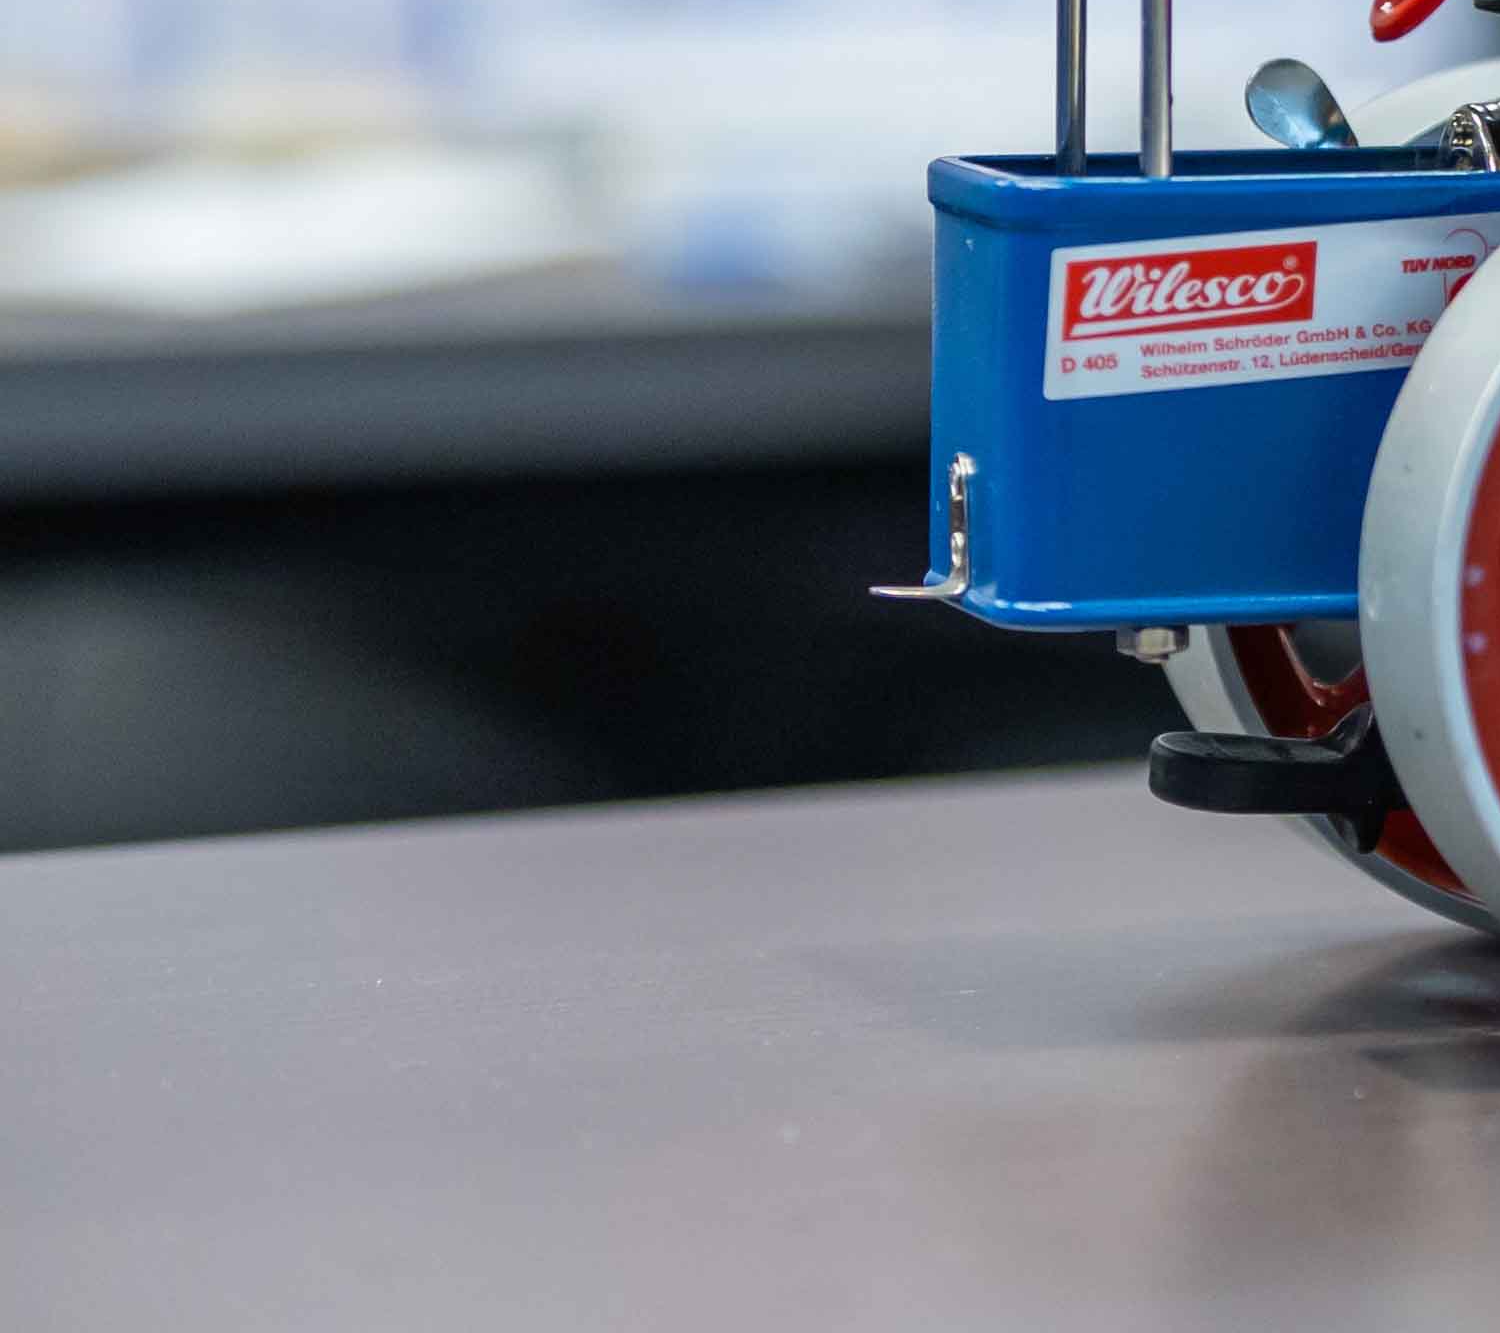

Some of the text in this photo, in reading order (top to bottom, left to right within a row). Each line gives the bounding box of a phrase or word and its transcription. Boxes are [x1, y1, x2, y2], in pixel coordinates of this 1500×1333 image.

[1432, 254, 1476, 271] NORD
[1140, 319, 1433, 358] Wilhelm Schröder GmbH & Co. KG
[1061, 353, 1118, 373] D 405
[1140, 343, 1424, 379] Schützenstr. 12, Lüdenscheid/Ger
